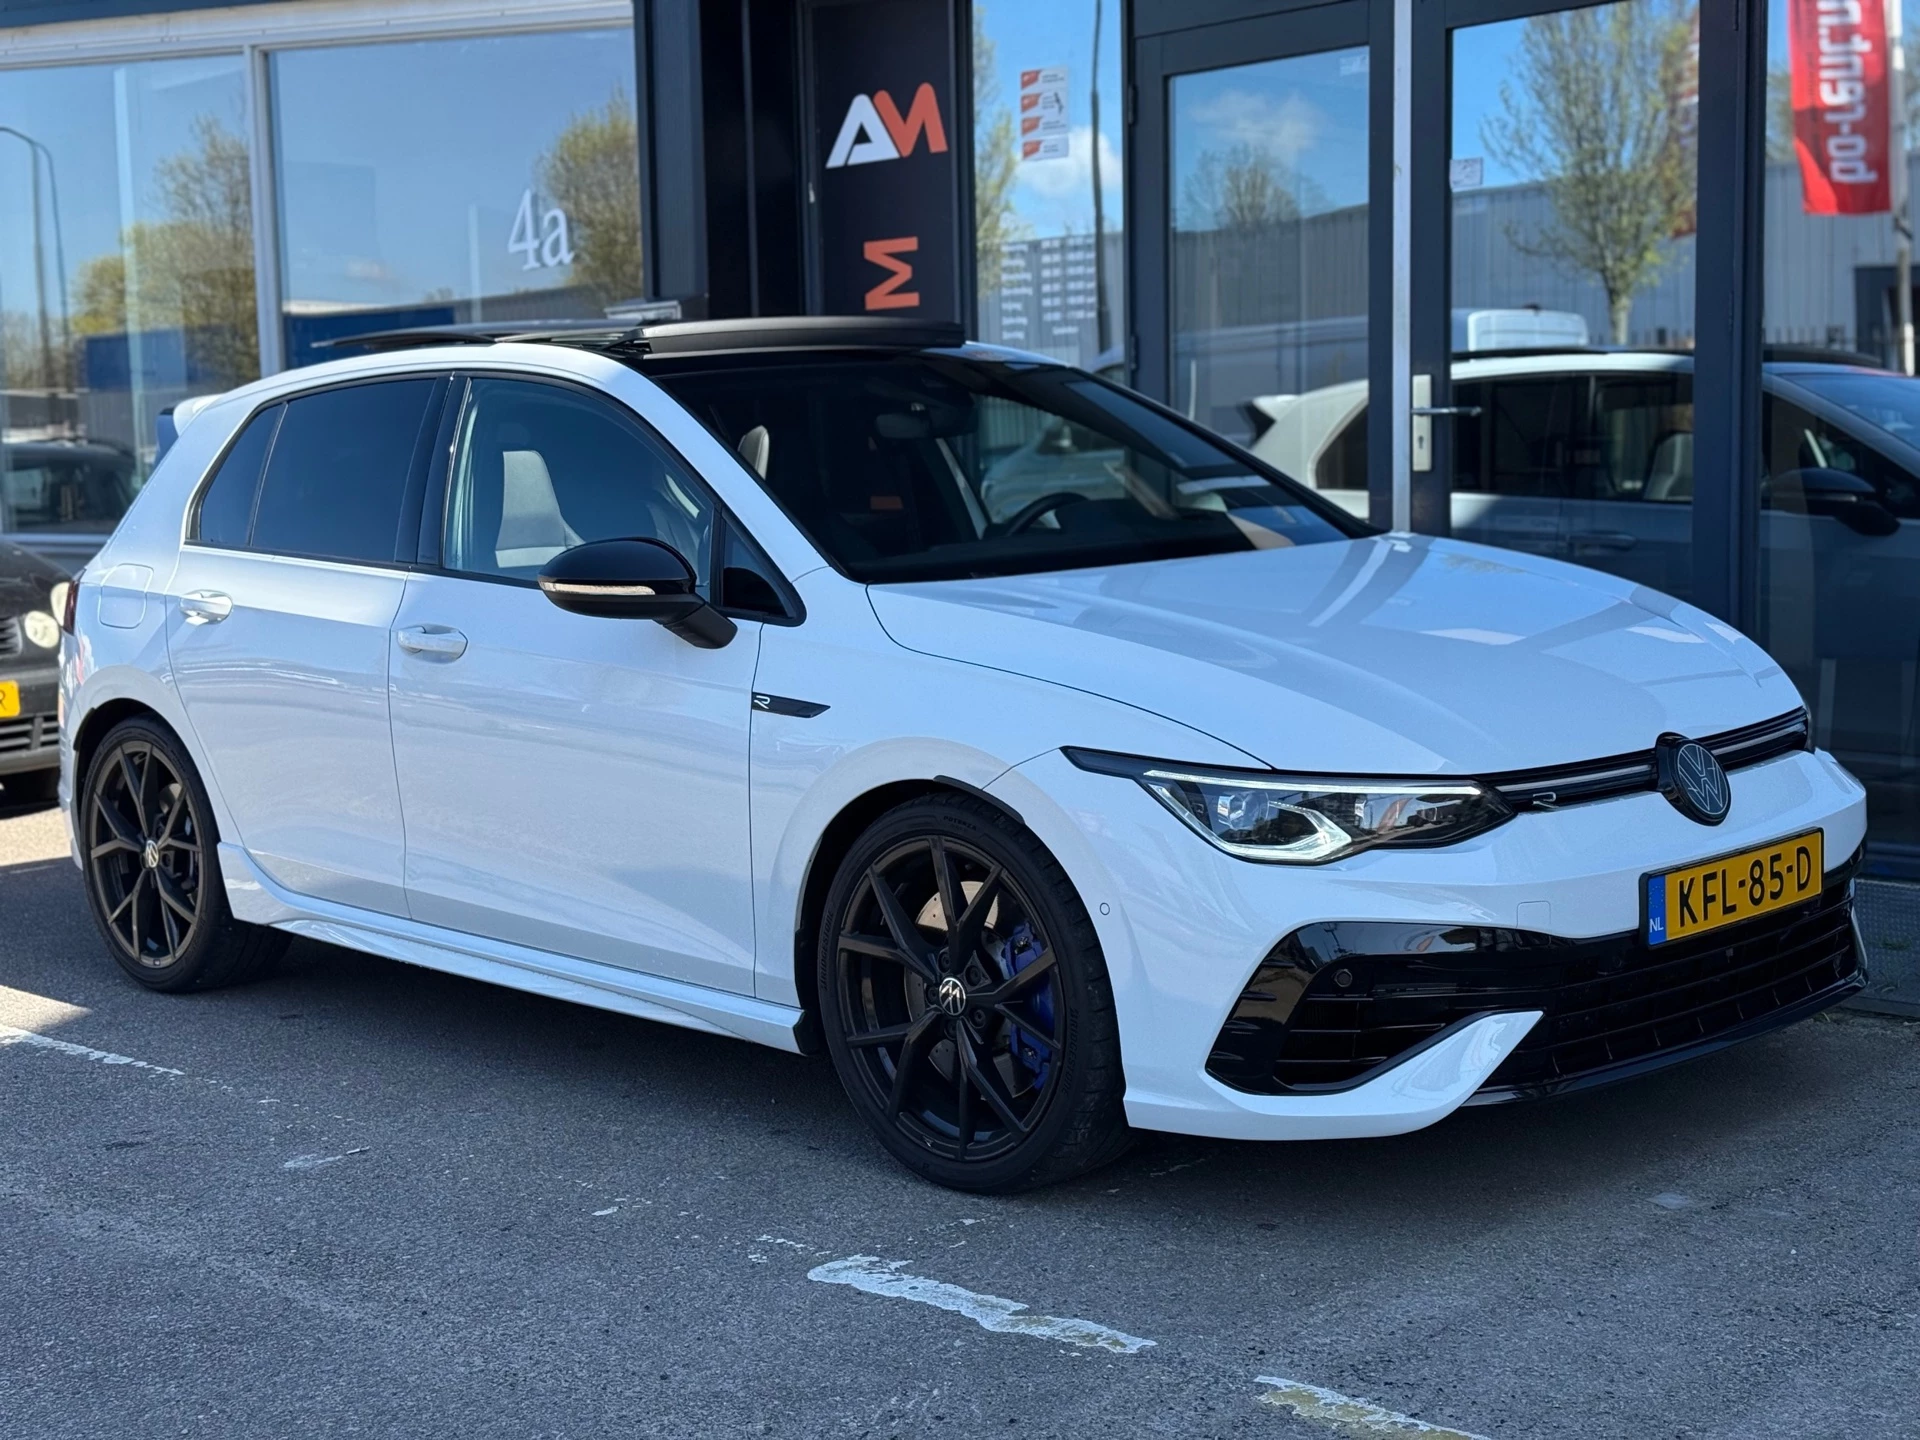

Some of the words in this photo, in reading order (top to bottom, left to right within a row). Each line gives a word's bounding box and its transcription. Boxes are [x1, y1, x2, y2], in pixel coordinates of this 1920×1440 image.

[826, 82, 948, 169] AM
[508, 188, 576, 271] 4a
[1650, 916, 1664, 933] NL
[1679, 846, 1812, 928] KFL-85-D
